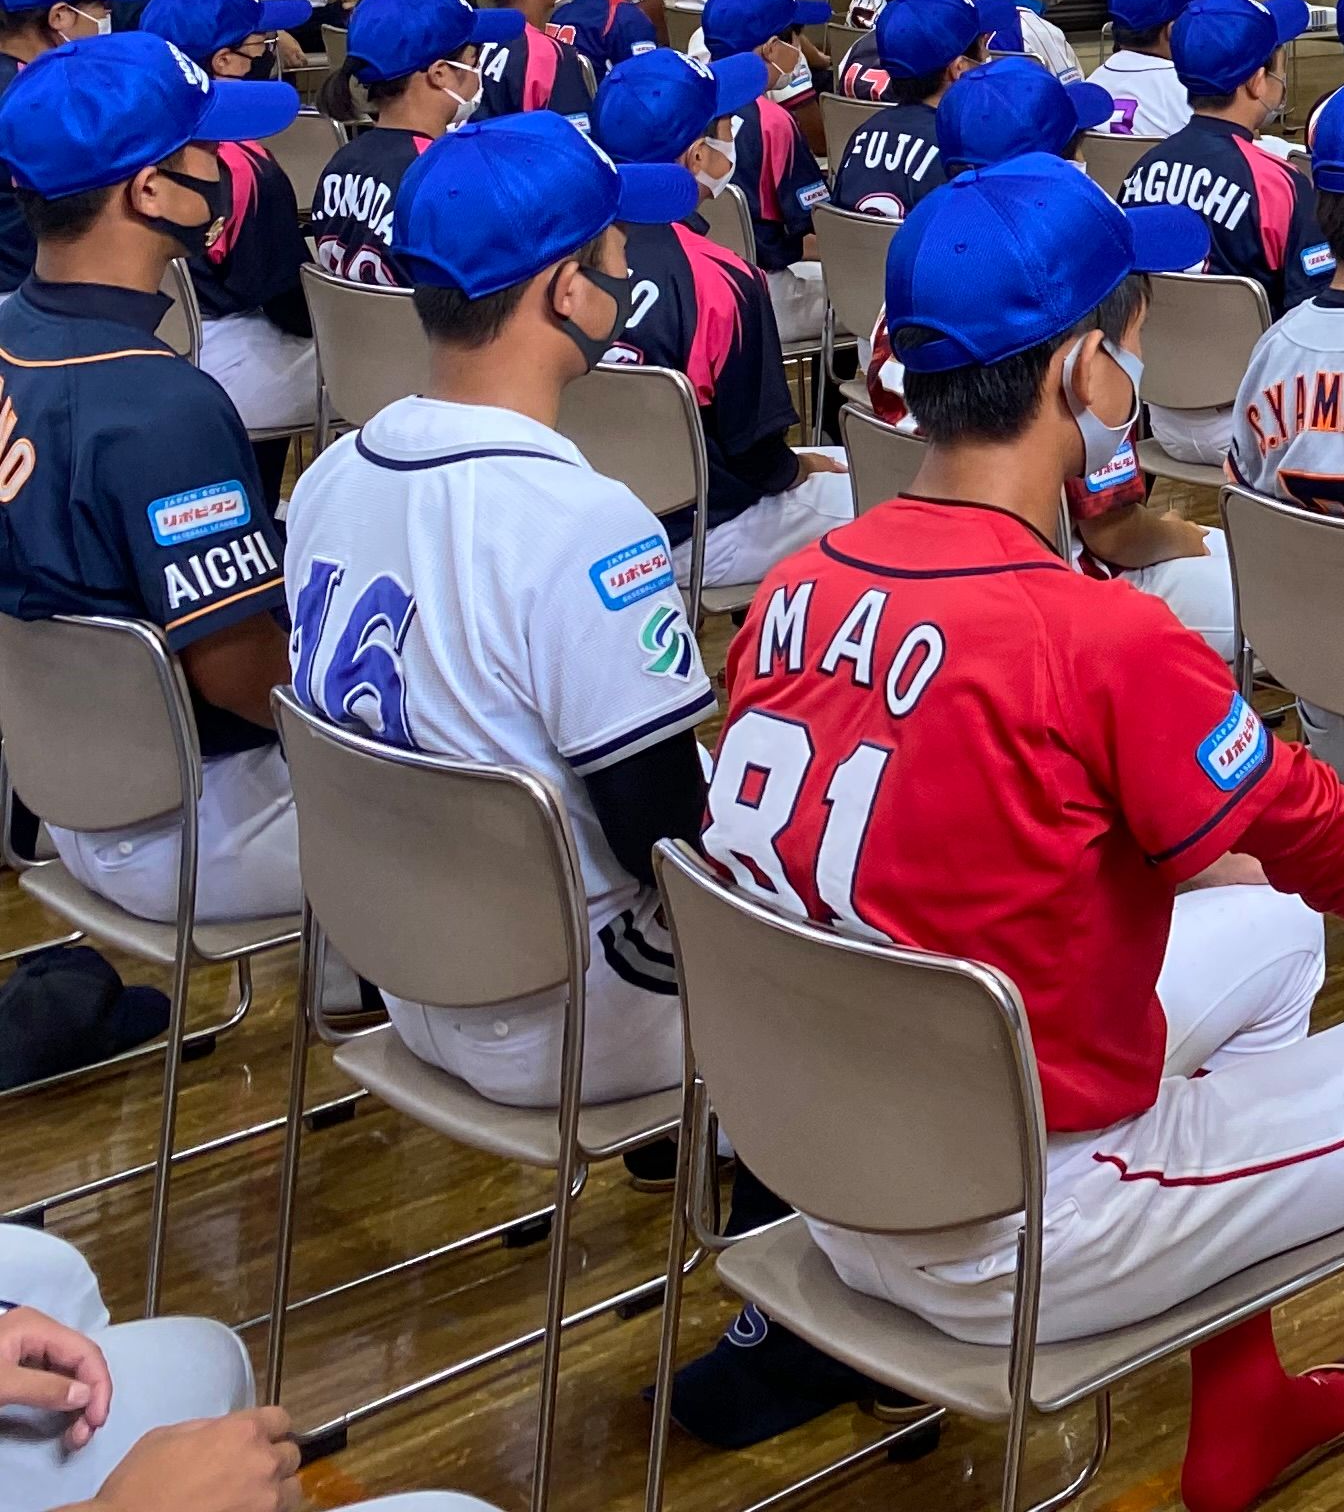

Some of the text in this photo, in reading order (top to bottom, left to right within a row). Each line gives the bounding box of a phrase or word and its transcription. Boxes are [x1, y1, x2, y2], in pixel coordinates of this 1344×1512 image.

[312, 174, 394, 246] .ONODA
[1122, 160, 1251, 231] AGUCHI
[163, 498, 237, 527] リポビタン
[163, 530, 278, 609] AICHI
[293, 556, 416, 747] 16
[756, 578, 945, 718] MAO
[701, 708, 894, 944] 81
